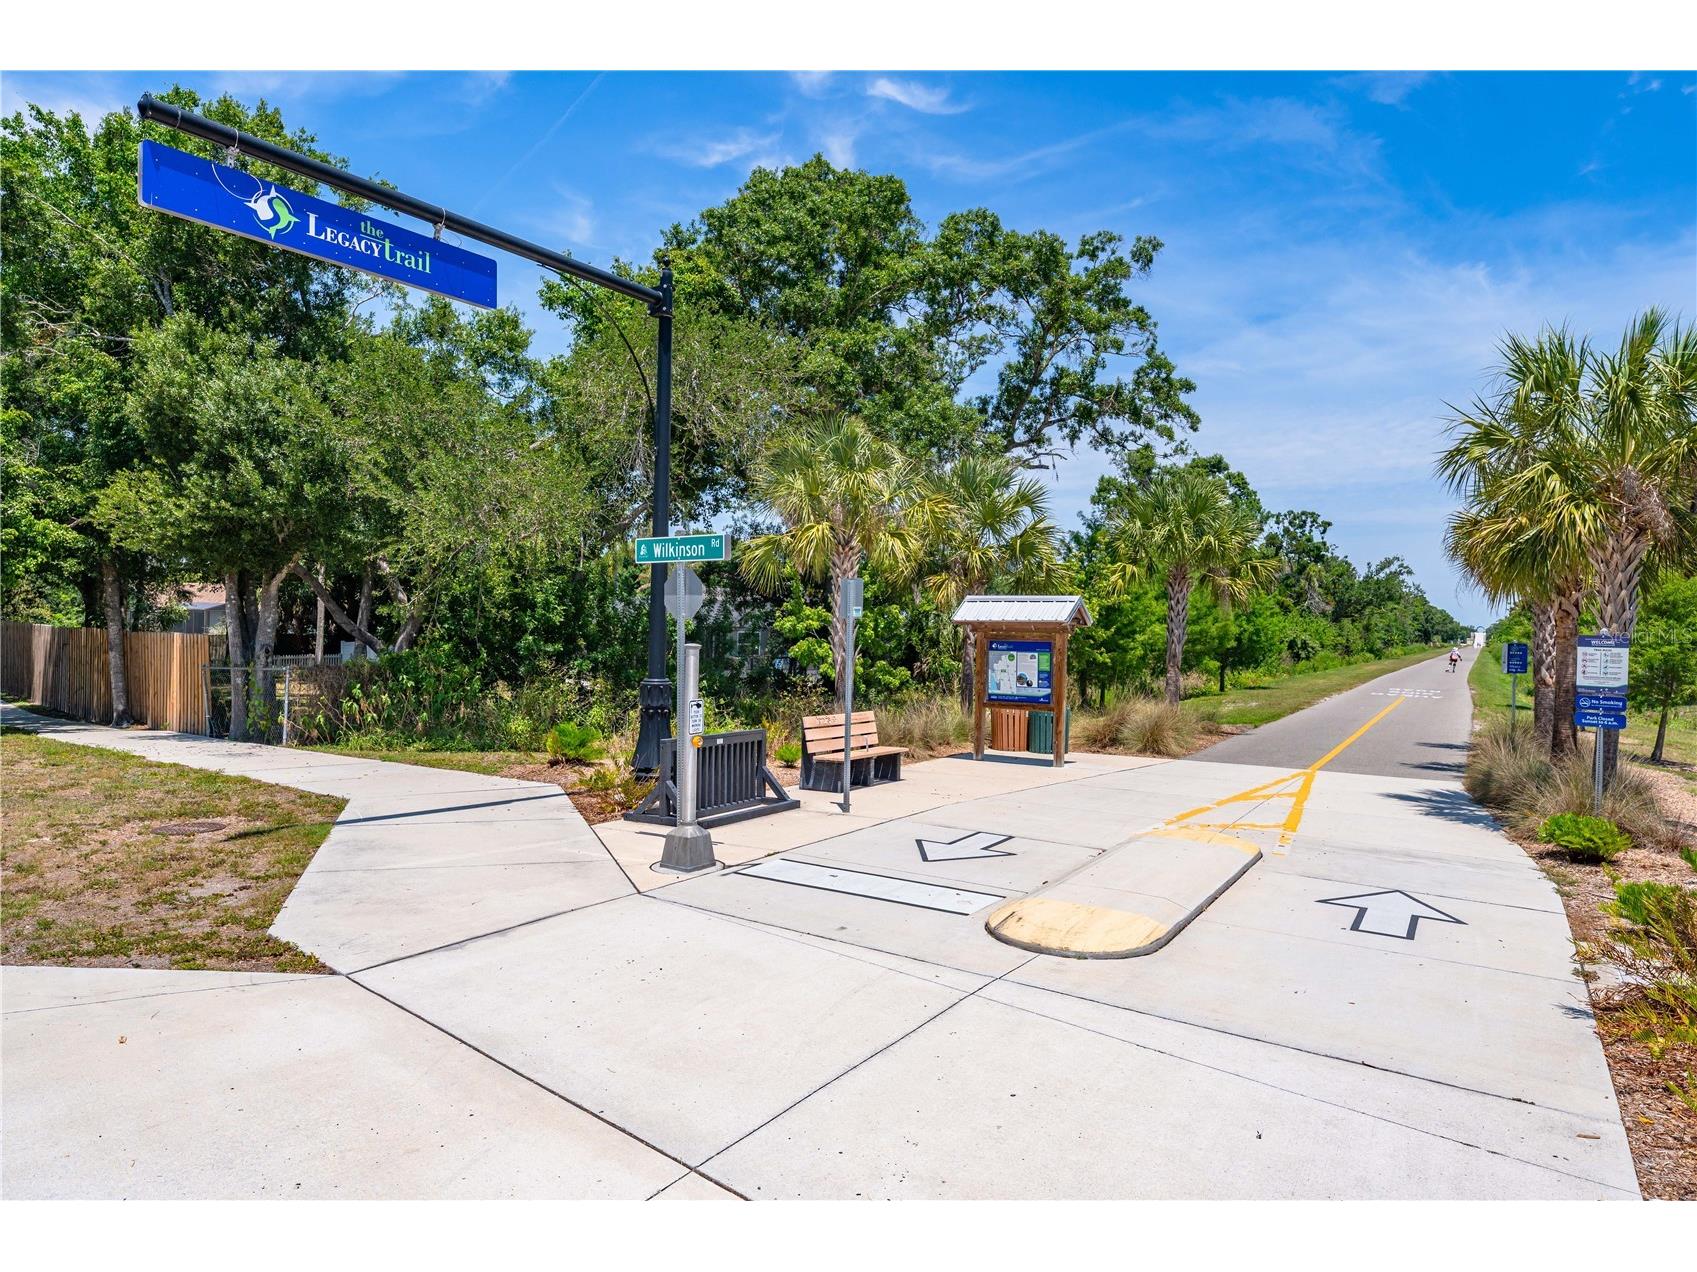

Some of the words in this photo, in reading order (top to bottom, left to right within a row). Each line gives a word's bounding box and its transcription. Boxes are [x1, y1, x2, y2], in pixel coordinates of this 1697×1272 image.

[360, 220, 384, 239] the
[306, 212, 382, 258] LEGACY
[384, 238, 431, 274] trail
[653, 542, 705, 558] Wilkinson
[711, 538, 720, 548] Rd
